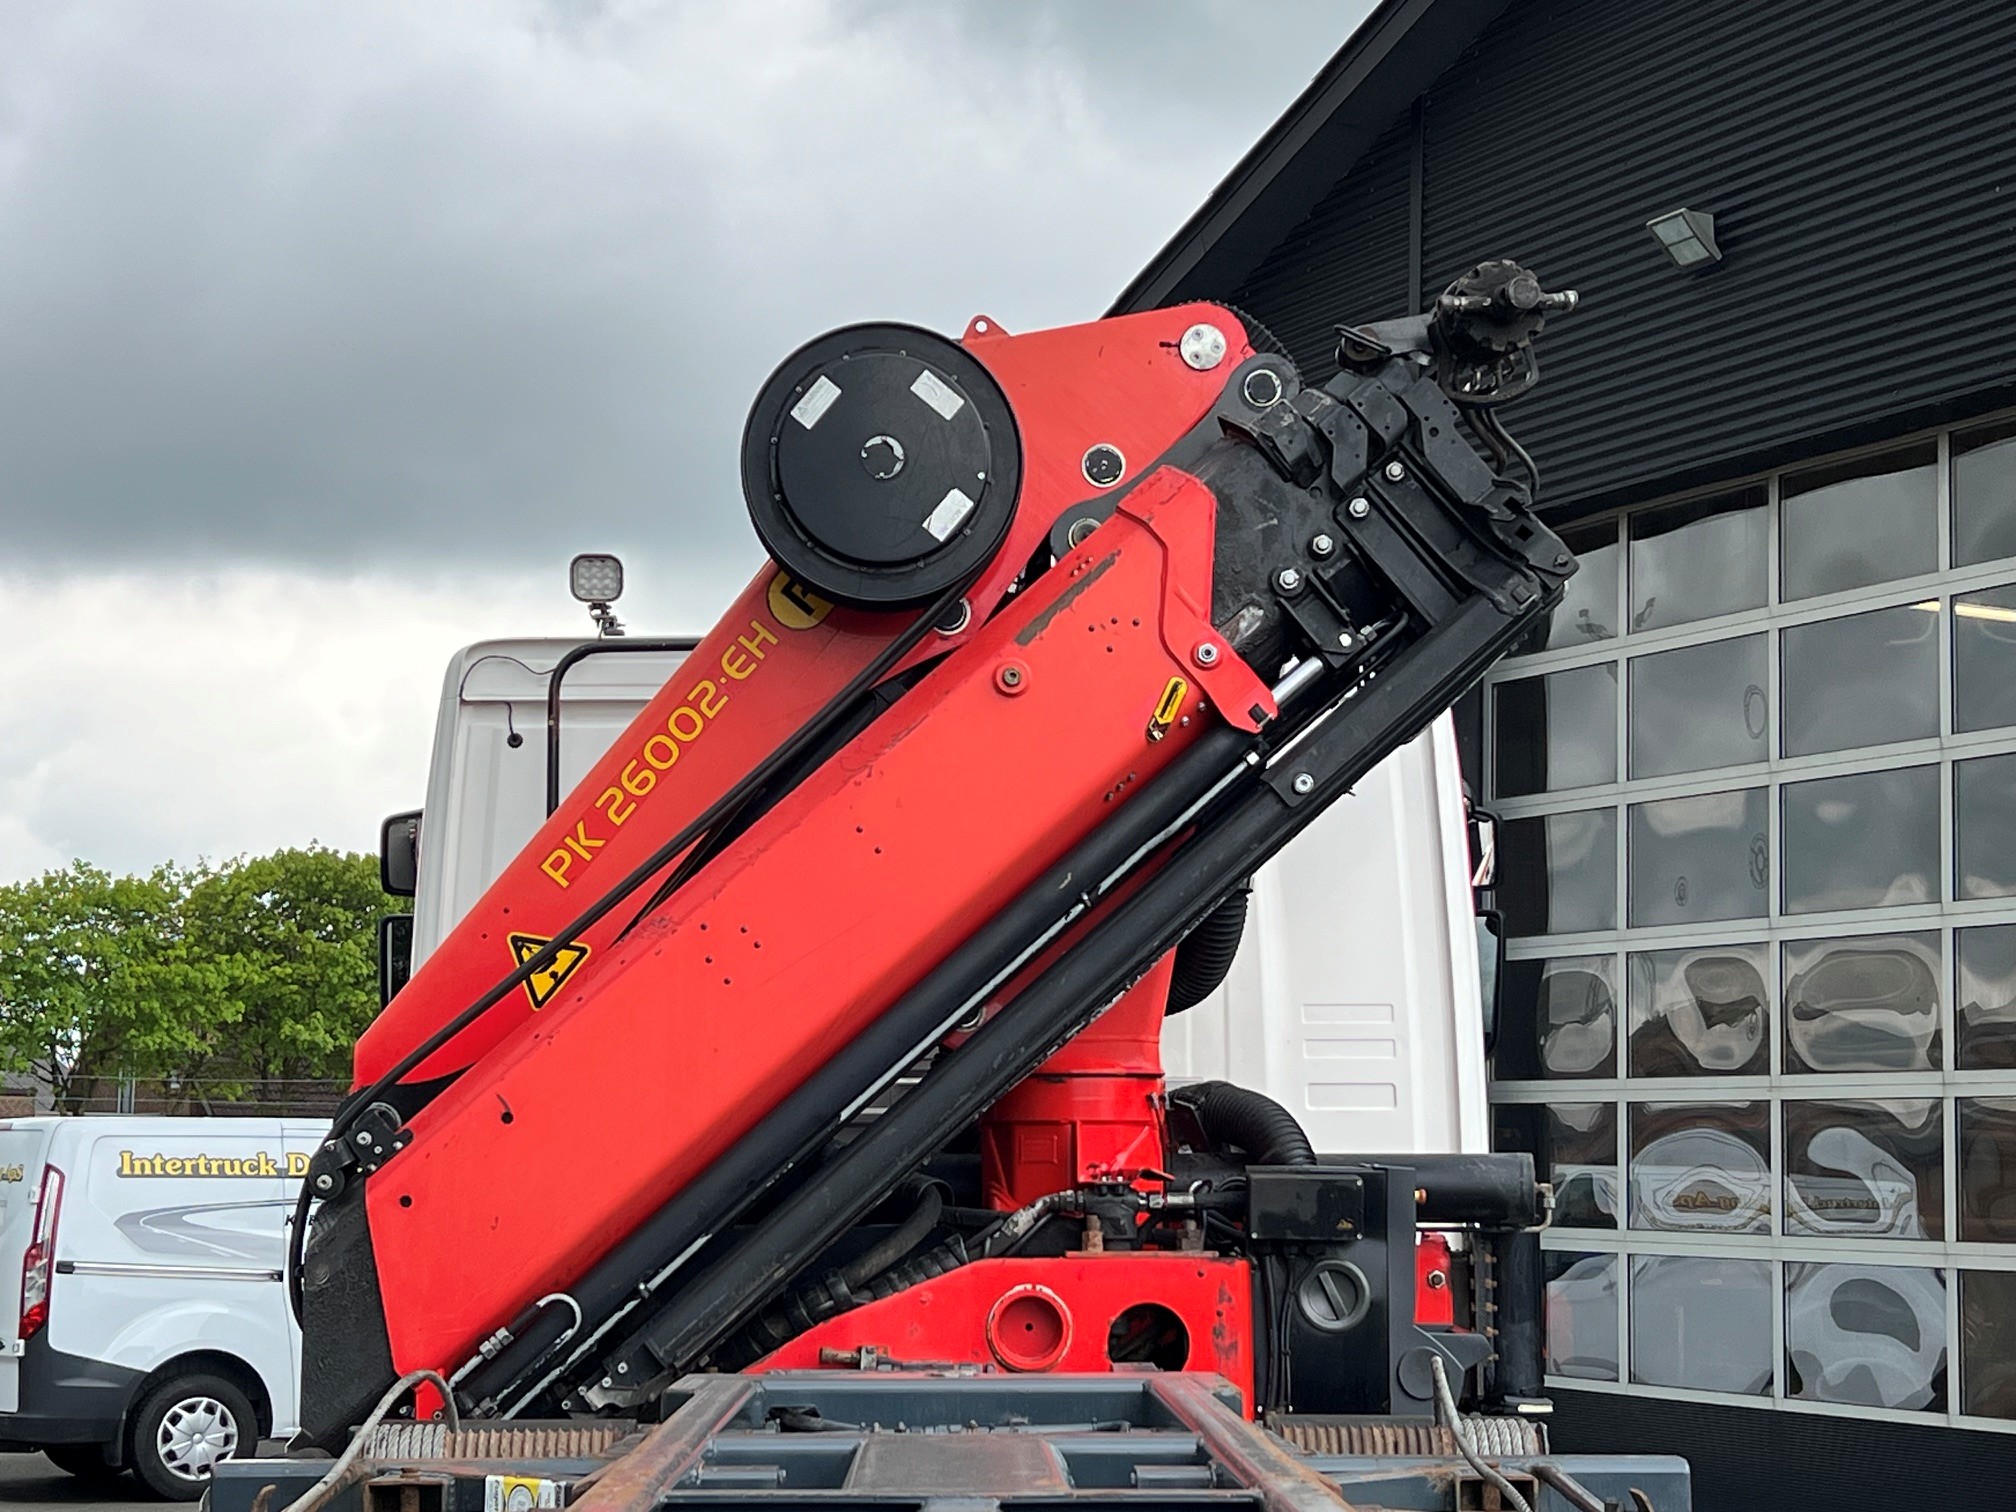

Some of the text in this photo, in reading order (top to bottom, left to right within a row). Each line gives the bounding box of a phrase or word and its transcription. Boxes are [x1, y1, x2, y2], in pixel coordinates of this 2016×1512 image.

[541, 820, 607, 889] PK
[119, 1151, 312, 1177] Intertruck D
